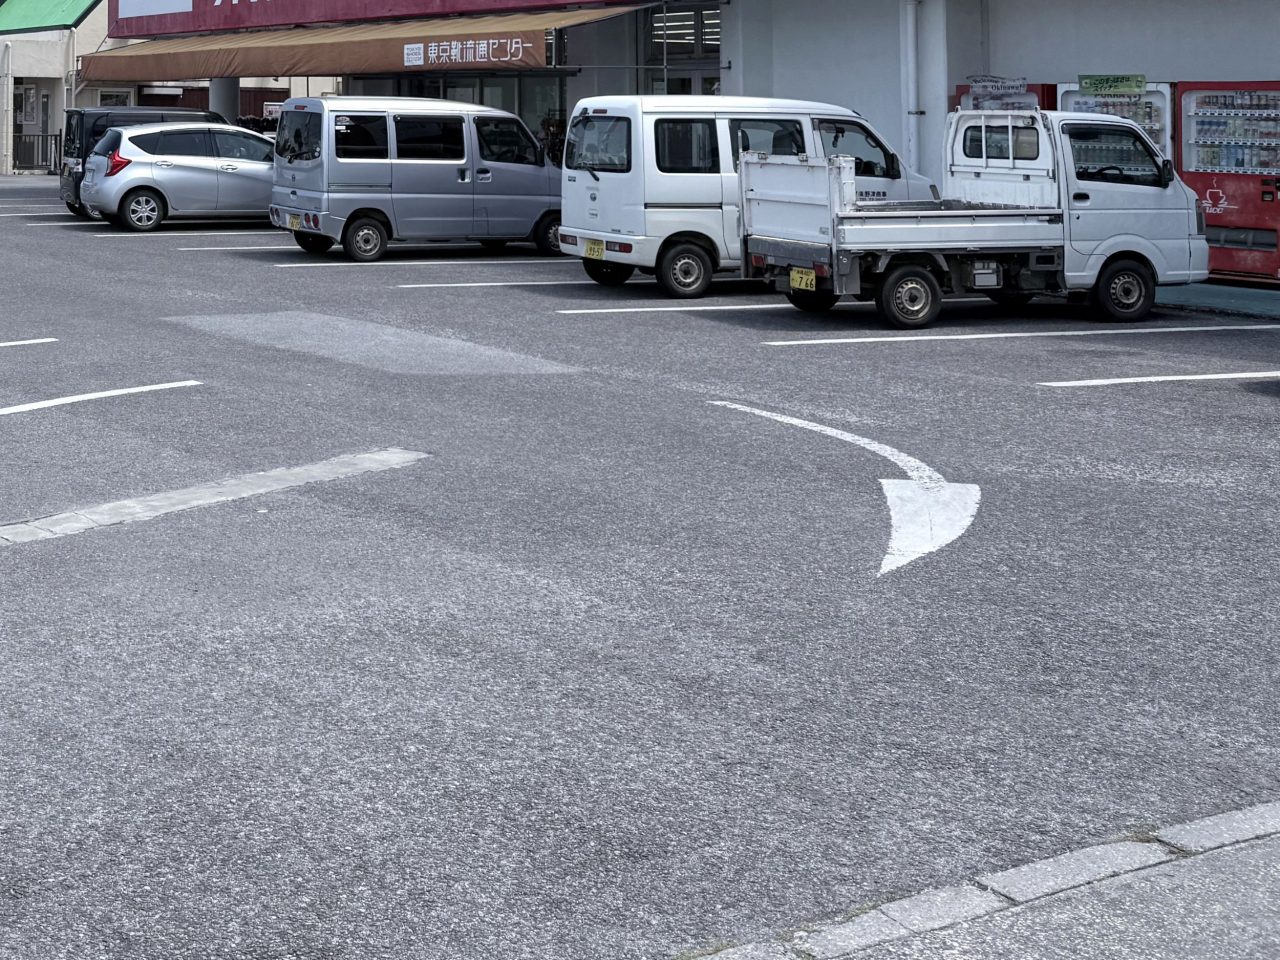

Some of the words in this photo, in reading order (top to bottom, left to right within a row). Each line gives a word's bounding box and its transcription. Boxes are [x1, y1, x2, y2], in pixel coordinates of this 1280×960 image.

[427, 38, 533, 65] 東京靴流通センター
